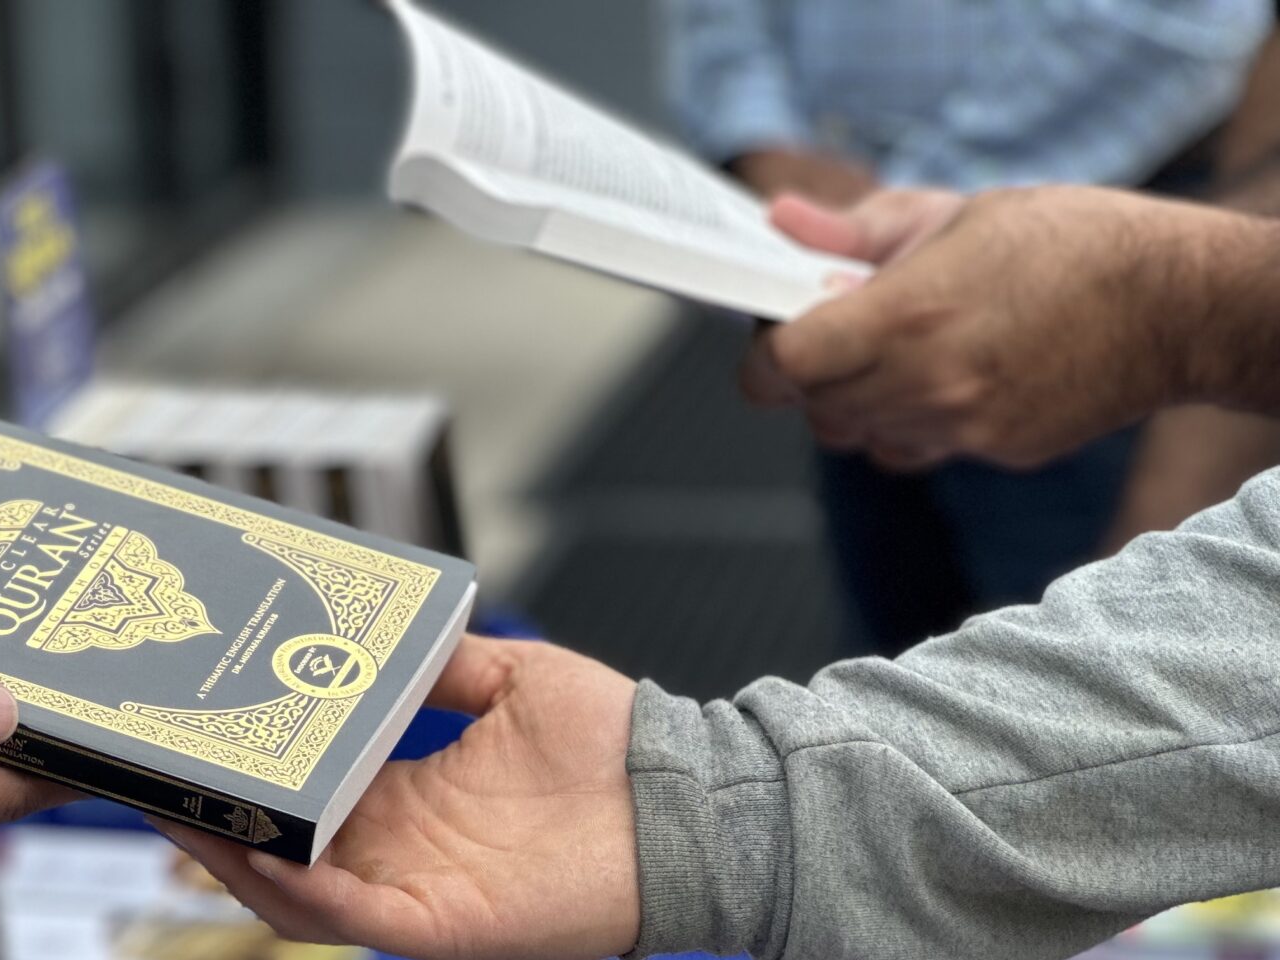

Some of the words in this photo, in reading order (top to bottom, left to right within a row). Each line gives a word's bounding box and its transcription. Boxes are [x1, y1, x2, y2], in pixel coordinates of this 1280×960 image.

[0, 506, 60, 571] CLEAR
[78, 522, 112, 559] Series
[33, 579, 88, 644] ENGLISH
[89, 531, 122, 570] ONLY
[199, 656, 232, 693] THEMATIC
[225, 626, 254, 658] ENGLISH
[246, 577, 287, 629] TRANSLATION
